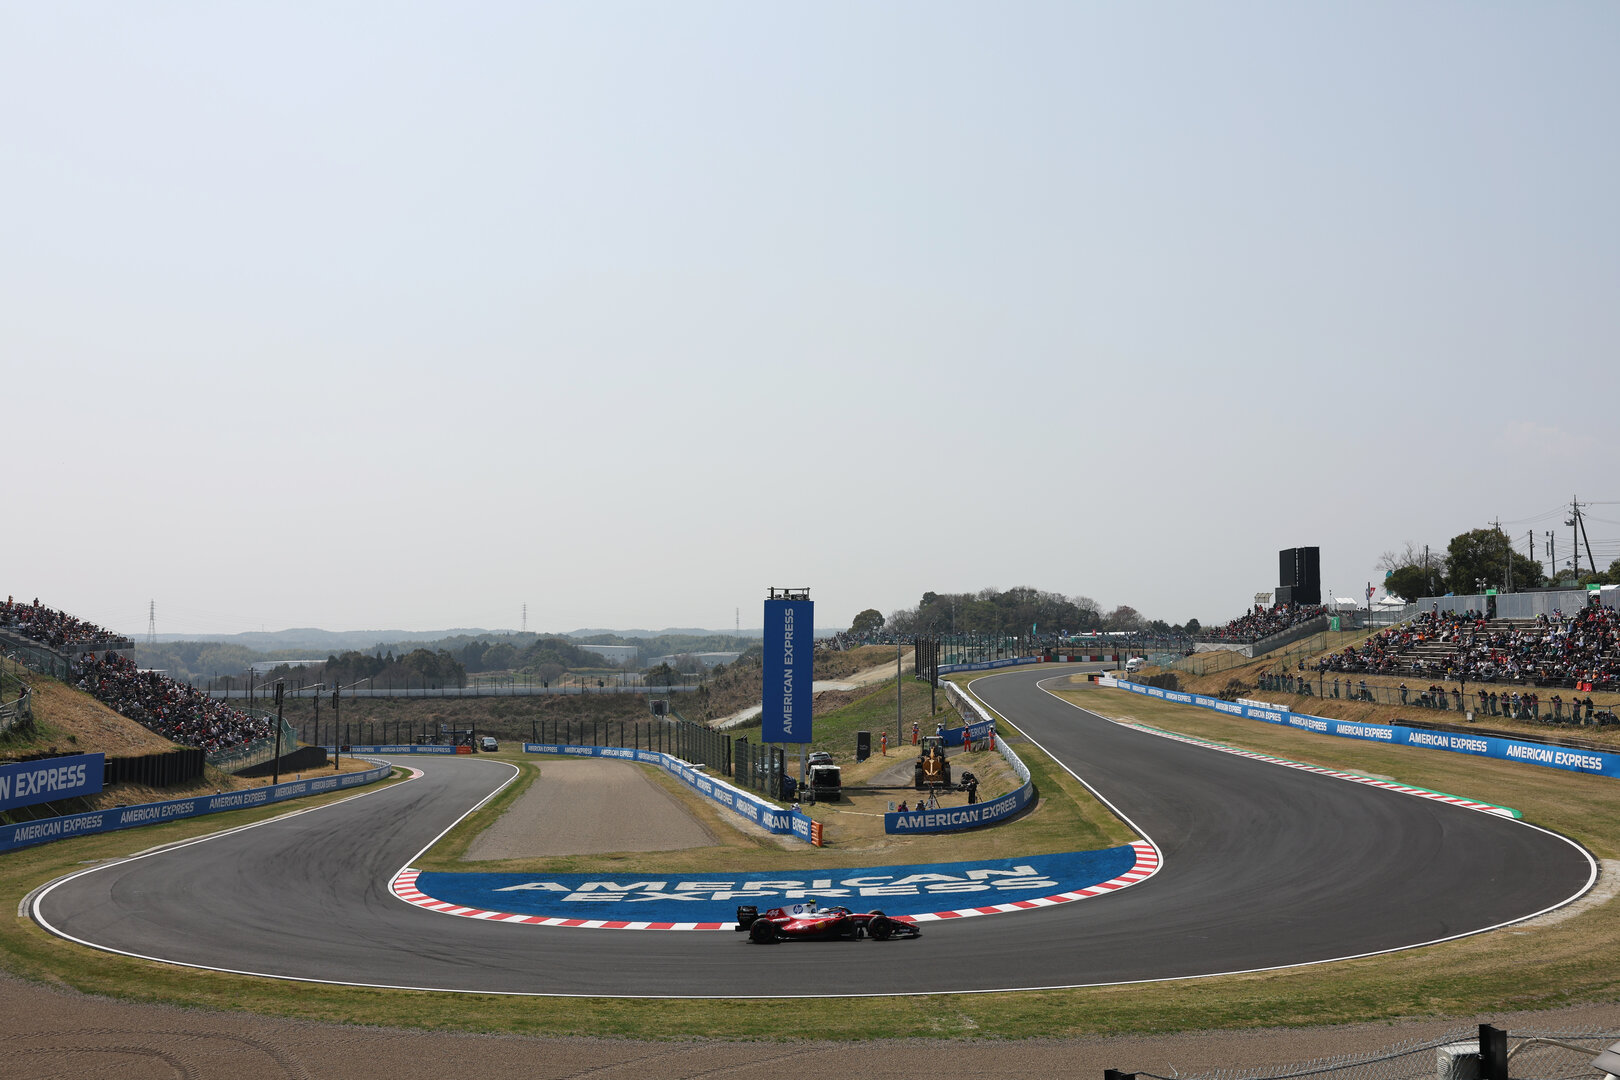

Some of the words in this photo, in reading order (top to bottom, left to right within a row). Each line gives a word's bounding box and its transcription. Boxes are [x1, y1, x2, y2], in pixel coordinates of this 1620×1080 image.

[784, 608, 794, 665] EXPRESS
[783, 669, 793, 735] AMERICAN
[1289, 715, 1308, 727] AMERICAN
[1308, 720, 1327, 731] EXPRESS
[1336, 724, 1364, 737] AMERICAN
[1364, 727, 1392, 740] EXPRESS
[1408, 732, 1449, 747] AMERICAN
[1450, 737, 1487, 753] EXPRESS
[1506, 745, 1553, 763] AMERICAN
[1554, 752, 1602, 770] EXPRESS
[15, 764, 86, 798] EXPRESS
[120, 806, 160, 824] AMERICAN
[161, 802, 194, 817] EXPRESS
[209, 794, 242, 809] AMERICAN
[244, 791, 267, 804] EXPRESS
[896, 810, 979, 829] AMERICAN
[982, 797, 1017, 820] EXPRESS
[14, 821, 61, 842] AMERICAN
[63, 815, 103, 833] EXPRESS
[491, 865, 1039, 892] AMERICAN
[560, 876, 1059, 902] EXPRESS
